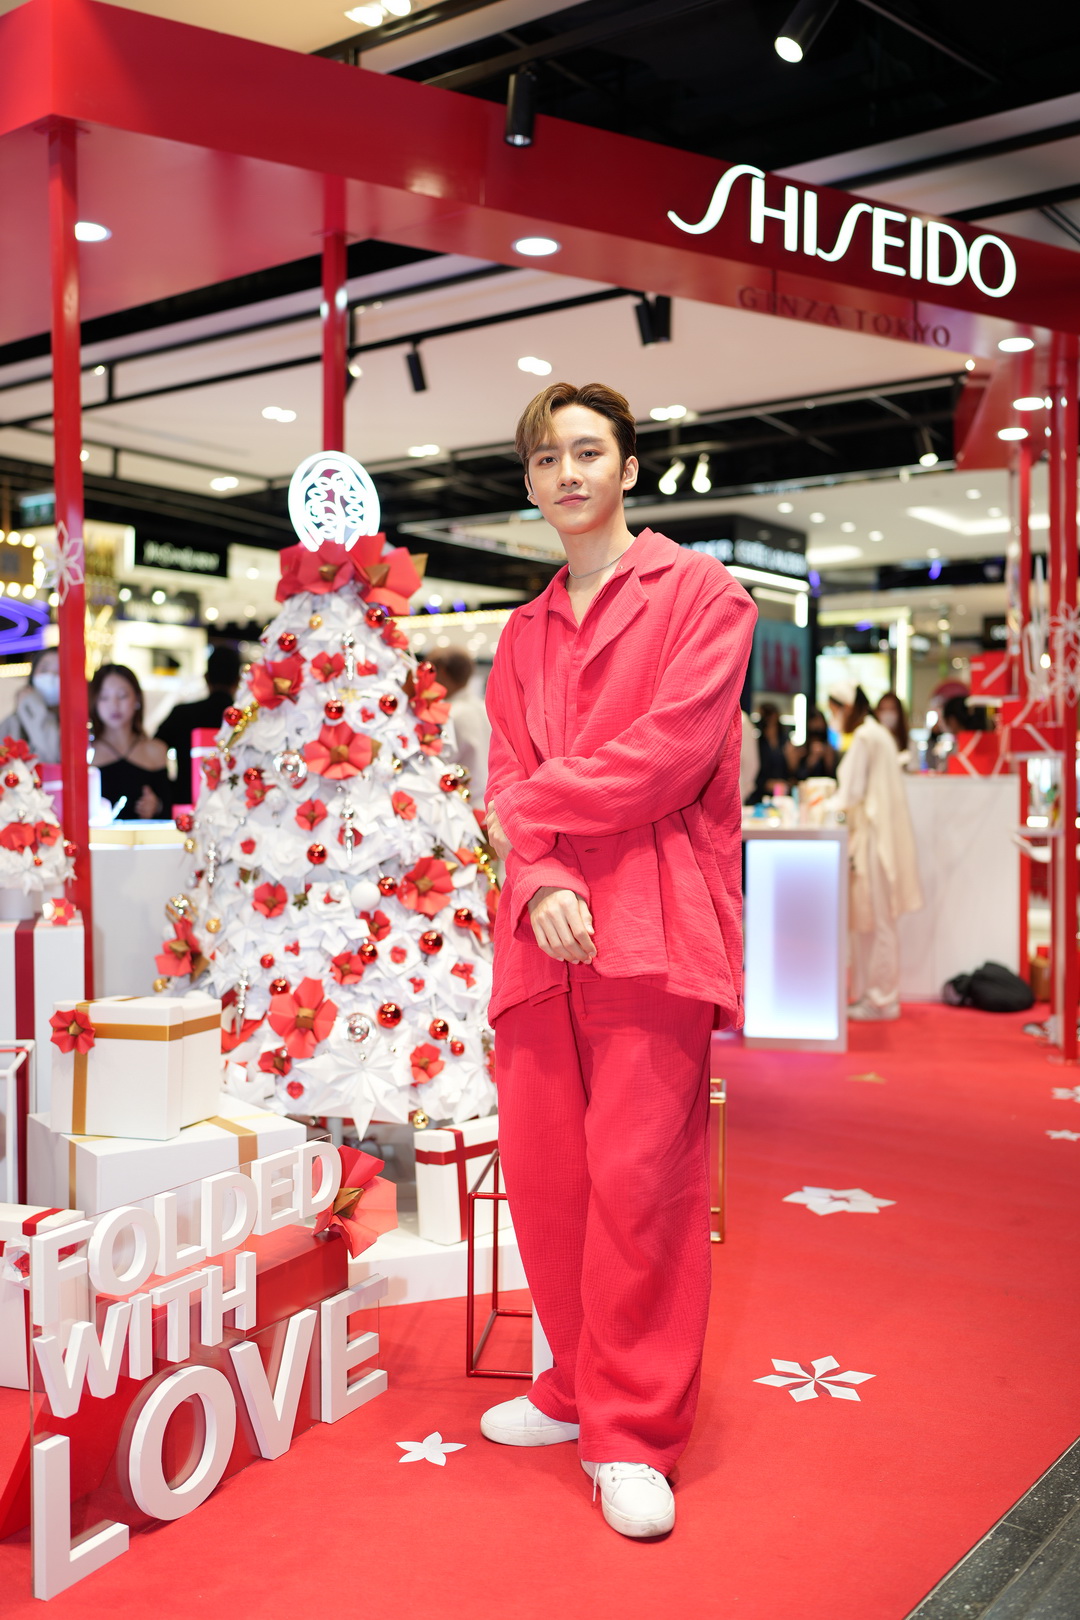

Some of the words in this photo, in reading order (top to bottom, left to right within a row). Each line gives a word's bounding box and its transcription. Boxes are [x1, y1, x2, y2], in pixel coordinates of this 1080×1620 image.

[667, 164, 1017, 298] SHISEIDO
[738, 286, 841, 327] GINZA
[855, 309, 951, 348] TOKYO
[31, 1141, 342, 1326] FOLDED
[33, 1251, 256, 1419] WITH
[32, 1274, 388, 1601] LOVE
